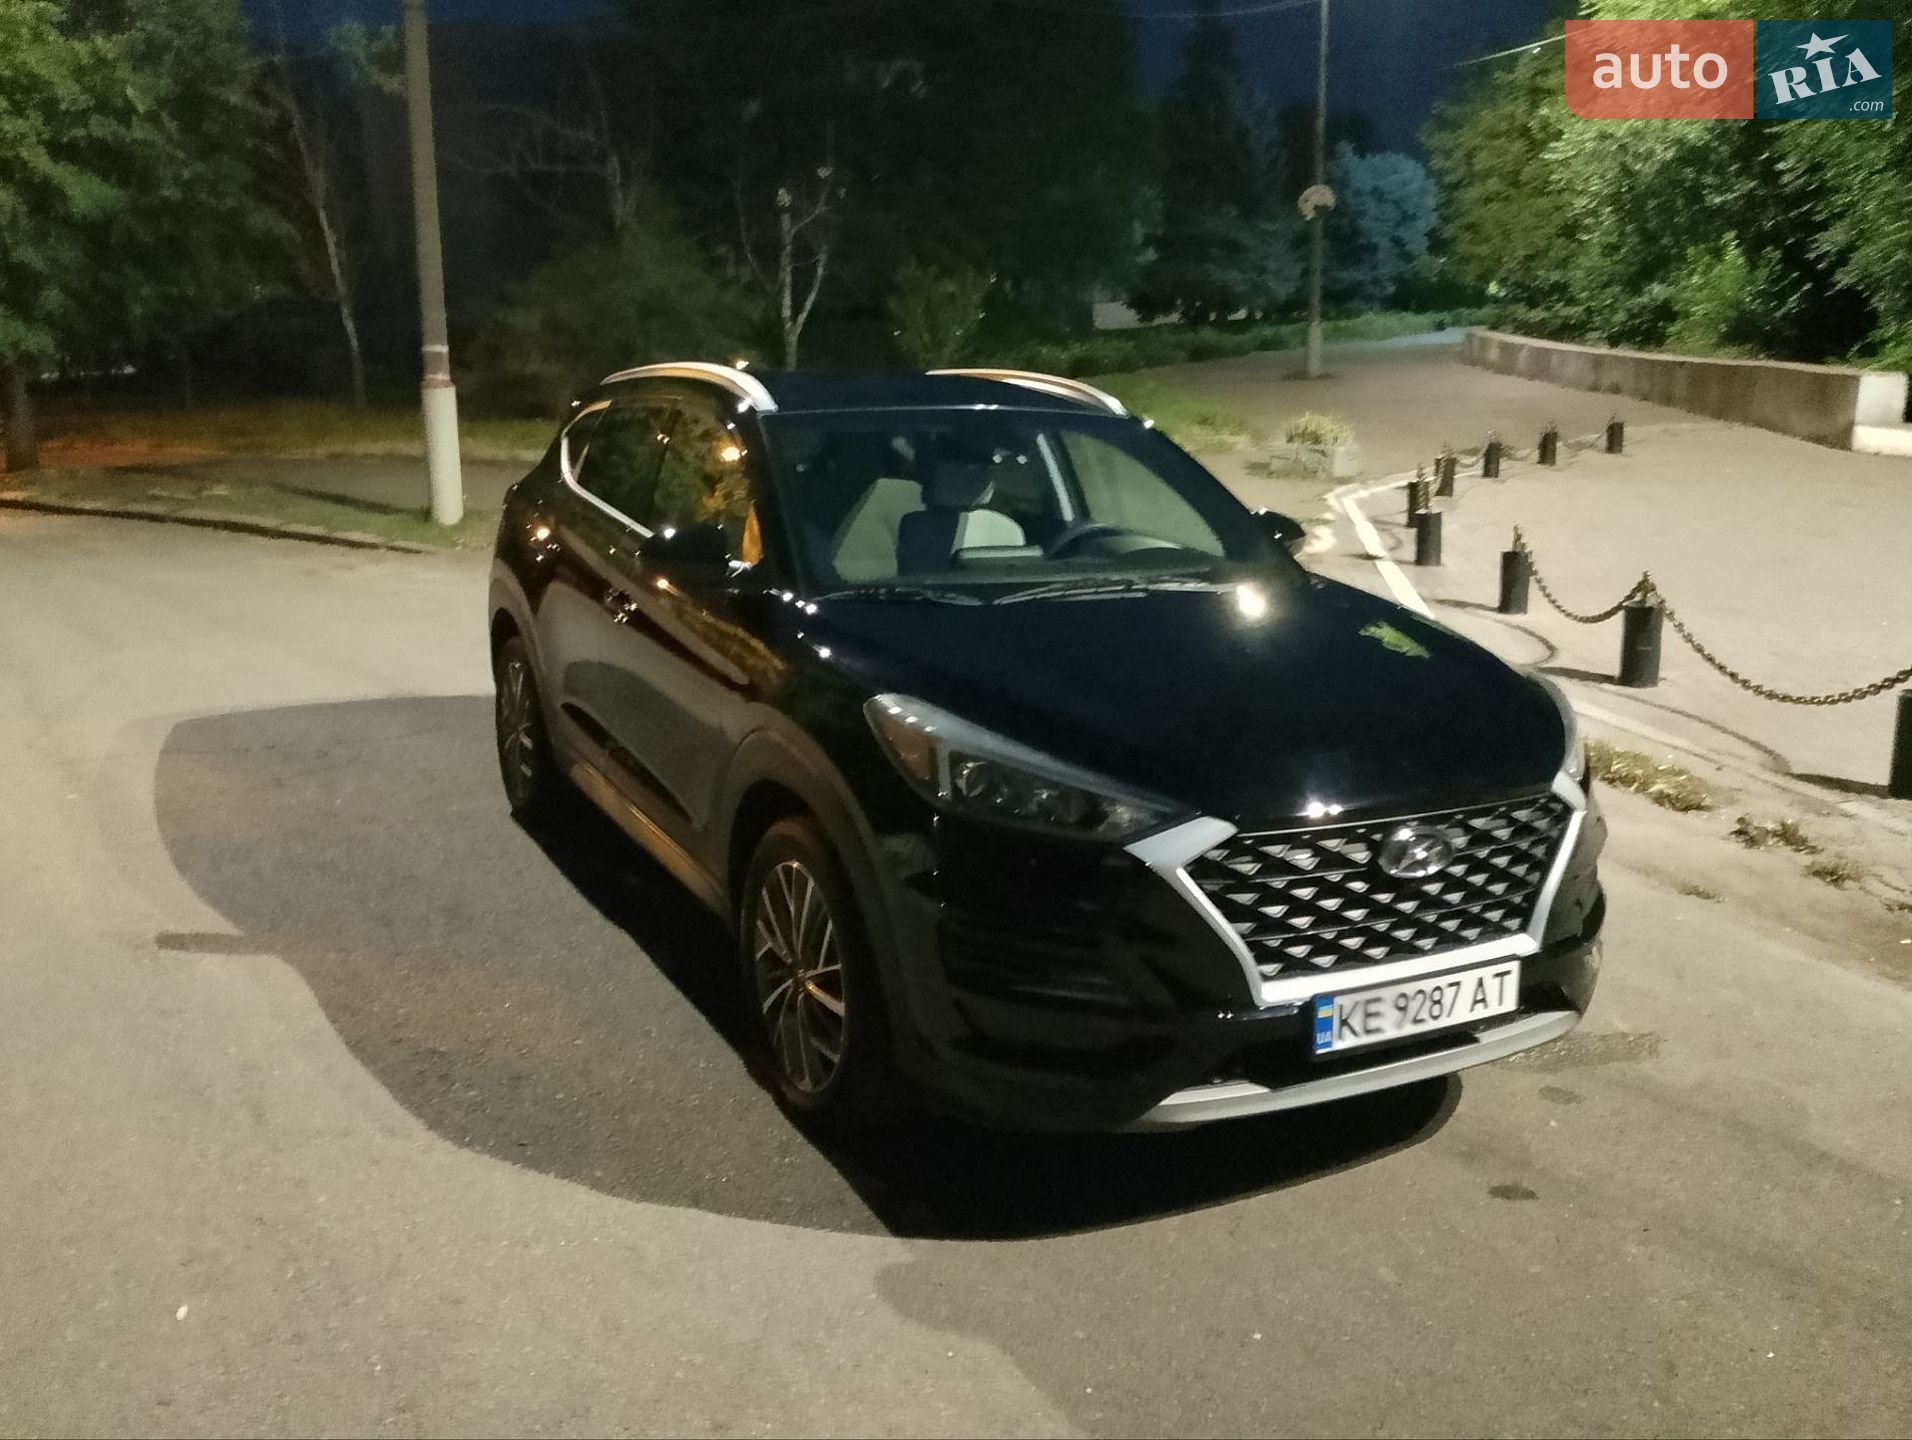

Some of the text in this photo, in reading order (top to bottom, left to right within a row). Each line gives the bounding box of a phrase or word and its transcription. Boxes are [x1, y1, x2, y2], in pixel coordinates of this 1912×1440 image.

[1337, 969, 1513, 1042] KE 9287 AT
[1316, 1030, 1332, 1045] UA
